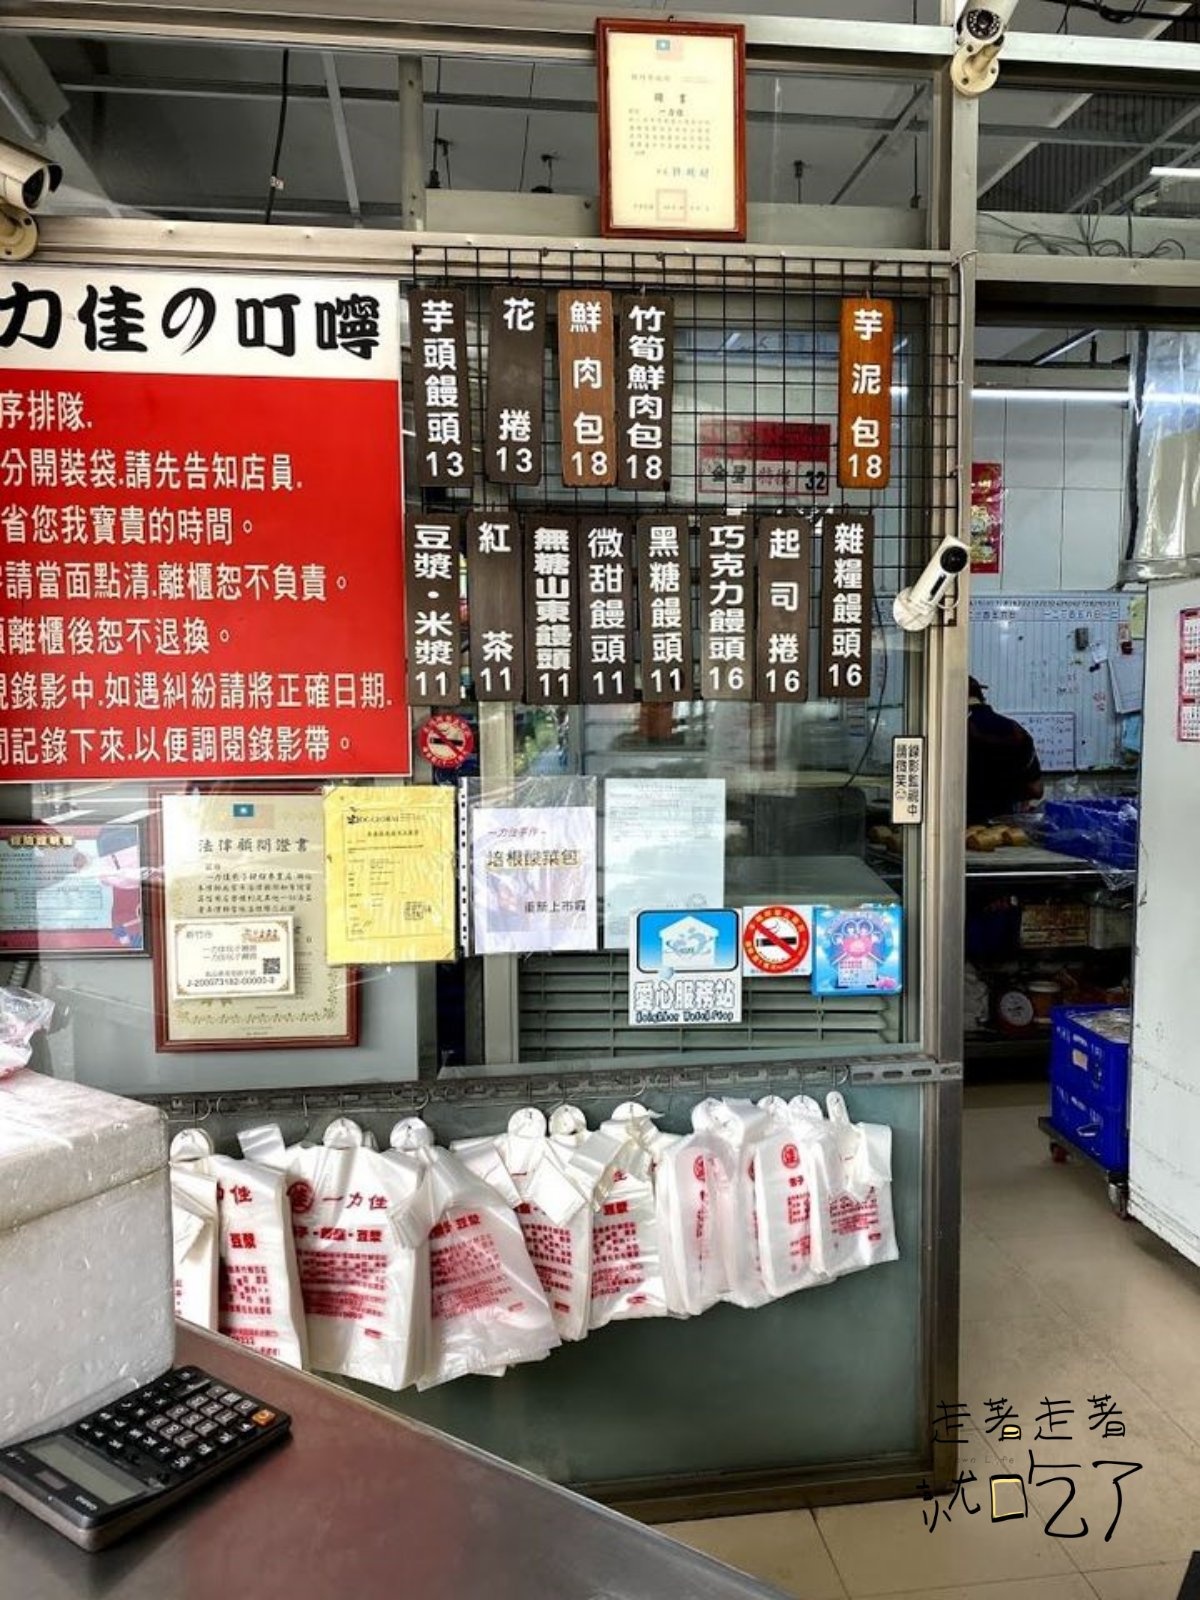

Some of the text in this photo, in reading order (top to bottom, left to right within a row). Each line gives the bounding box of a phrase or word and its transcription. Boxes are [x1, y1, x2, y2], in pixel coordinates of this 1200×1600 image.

[421, 299, 464, 477] 芋頭饅頭 13
[496, 297, 535, 472] 花捲 13
[569, 300, 608, 476] 鮮肉包 18
[626, 305, 666, 480] 竹筍鮮肉包 18
[848, 309, 884, 479] 芋泥包 18
[805, 469, 826, 491] 32
[0, 614, 230, 656] 離櫃後恕不退換。
[478, 522, 514, 692] 紅茶 11
[534, 527, 572, 697] 無糖山東饅頭 11
[588, 527, 626, 695] 微甜饅頭 11
[649, 526, 683, 692] 黑糖饅頭 11
[708, 524, 746, 661] 巧克力饅頭
[766, 528, 800, 693] 起司捲 16
[828, 522, 864, 687] 雜糧饅頭 16
[415, 671, 447, 696] 11
[709, 667, 744, 691] 16
[322, 1191, 388, 1211] 一力佳
